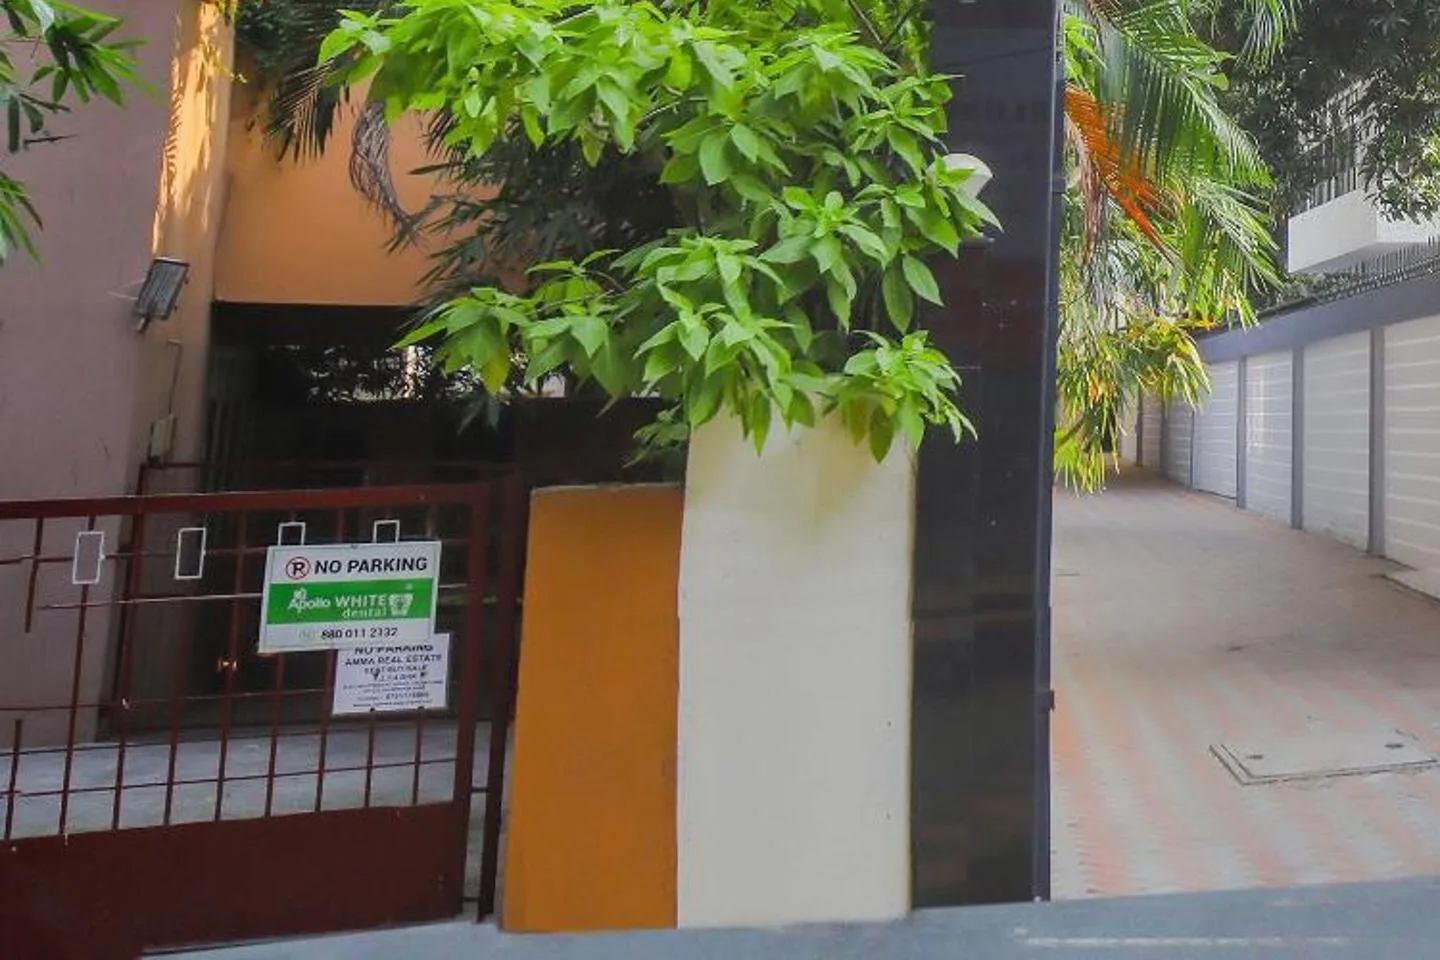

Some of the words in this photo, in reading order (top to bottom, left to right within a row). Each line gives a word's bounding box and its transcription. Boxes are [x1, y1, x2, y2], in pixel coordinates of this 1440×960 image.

[314, 560, 342, 574] NO
[347, 557, 428, 573] PARKING
[287, 593, 331, 613] Apollo
[335, 594, 387, 608] WHITE
[341, 607, 387, 619] dental
